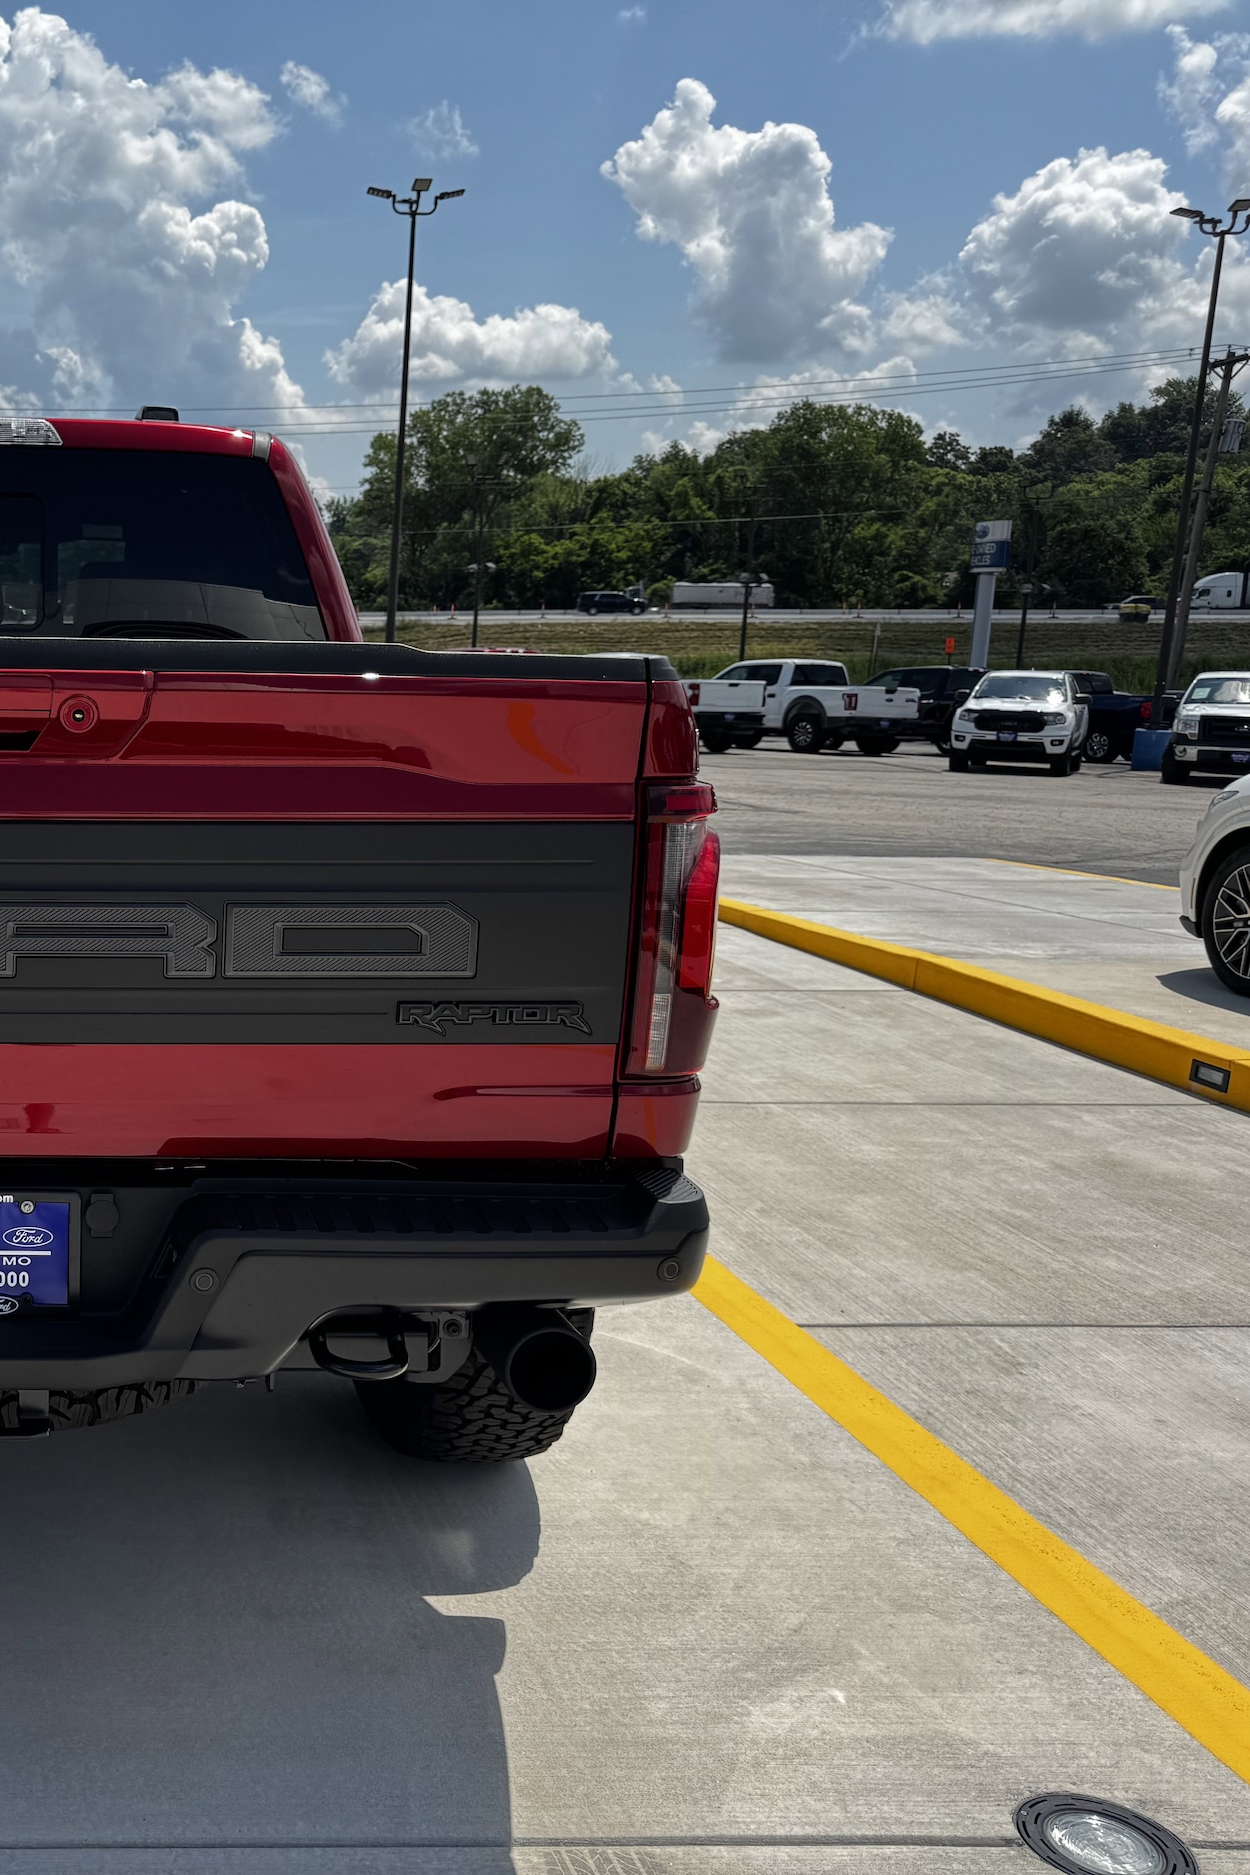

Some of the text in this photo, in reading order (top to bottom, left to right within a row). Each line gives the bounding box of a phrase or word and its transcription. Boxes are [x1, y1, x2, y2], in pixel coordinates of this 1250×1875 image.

[398, 1002, 592, 1035] RAPTOR
[12, 1228, 44, 1244] Ford
[2, 1256, 32, 1266] MO
